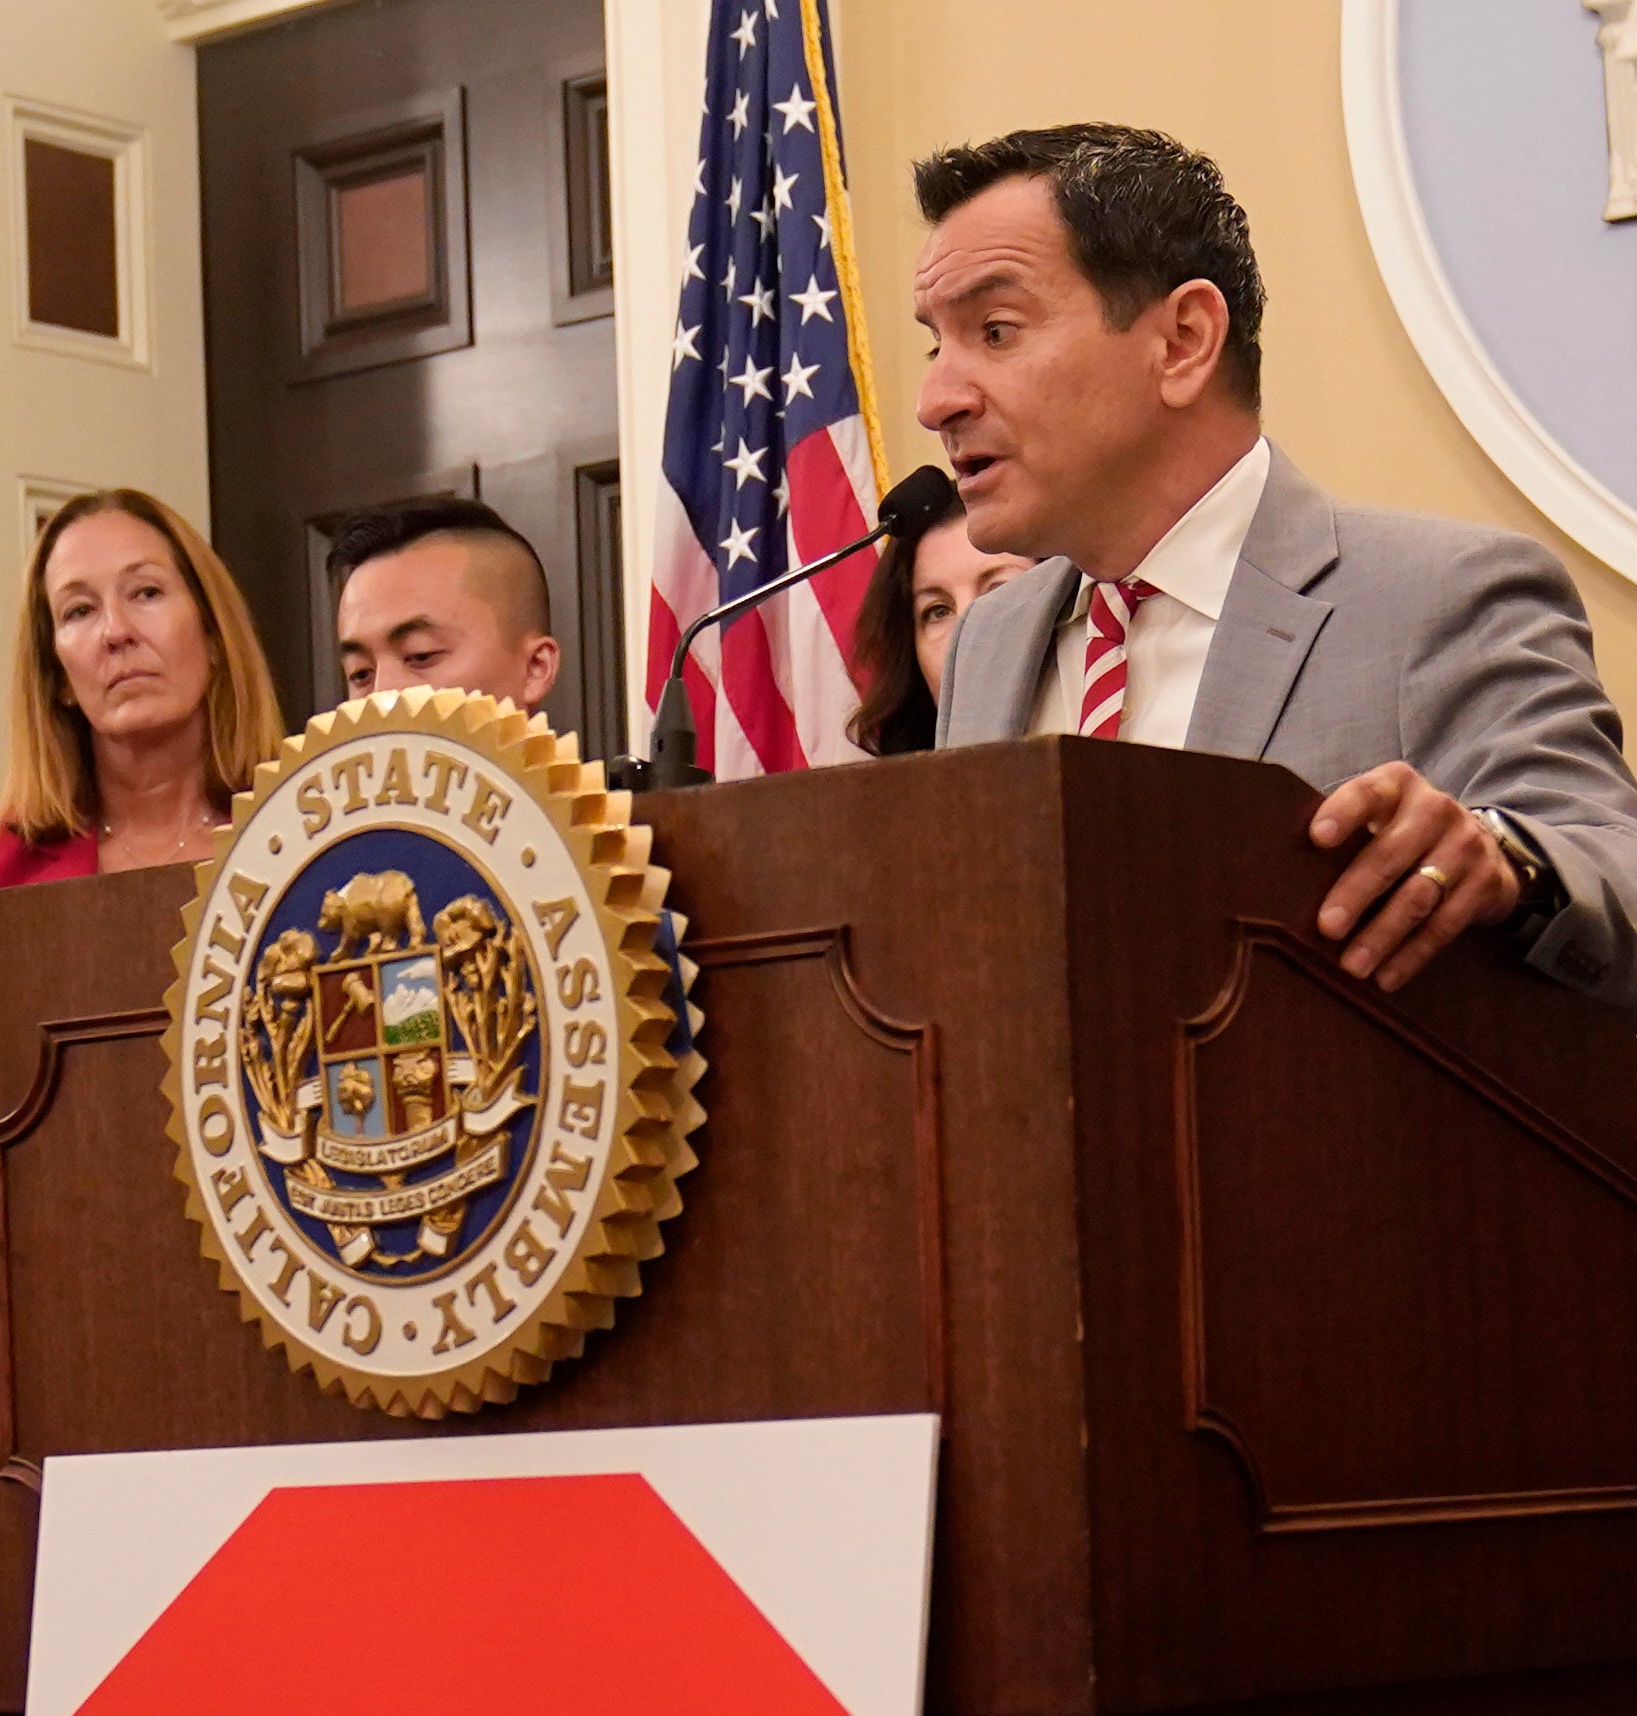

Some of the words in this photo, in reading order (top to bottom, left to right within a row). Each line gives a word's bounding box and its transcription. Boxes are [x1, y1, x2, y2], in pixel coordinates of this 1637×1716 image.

[192, 868, 382, 1355] CALIFORNIA
[296, 748, 513, 845] STATE
[431, 895, 607, 1355] ASSEMBLY
